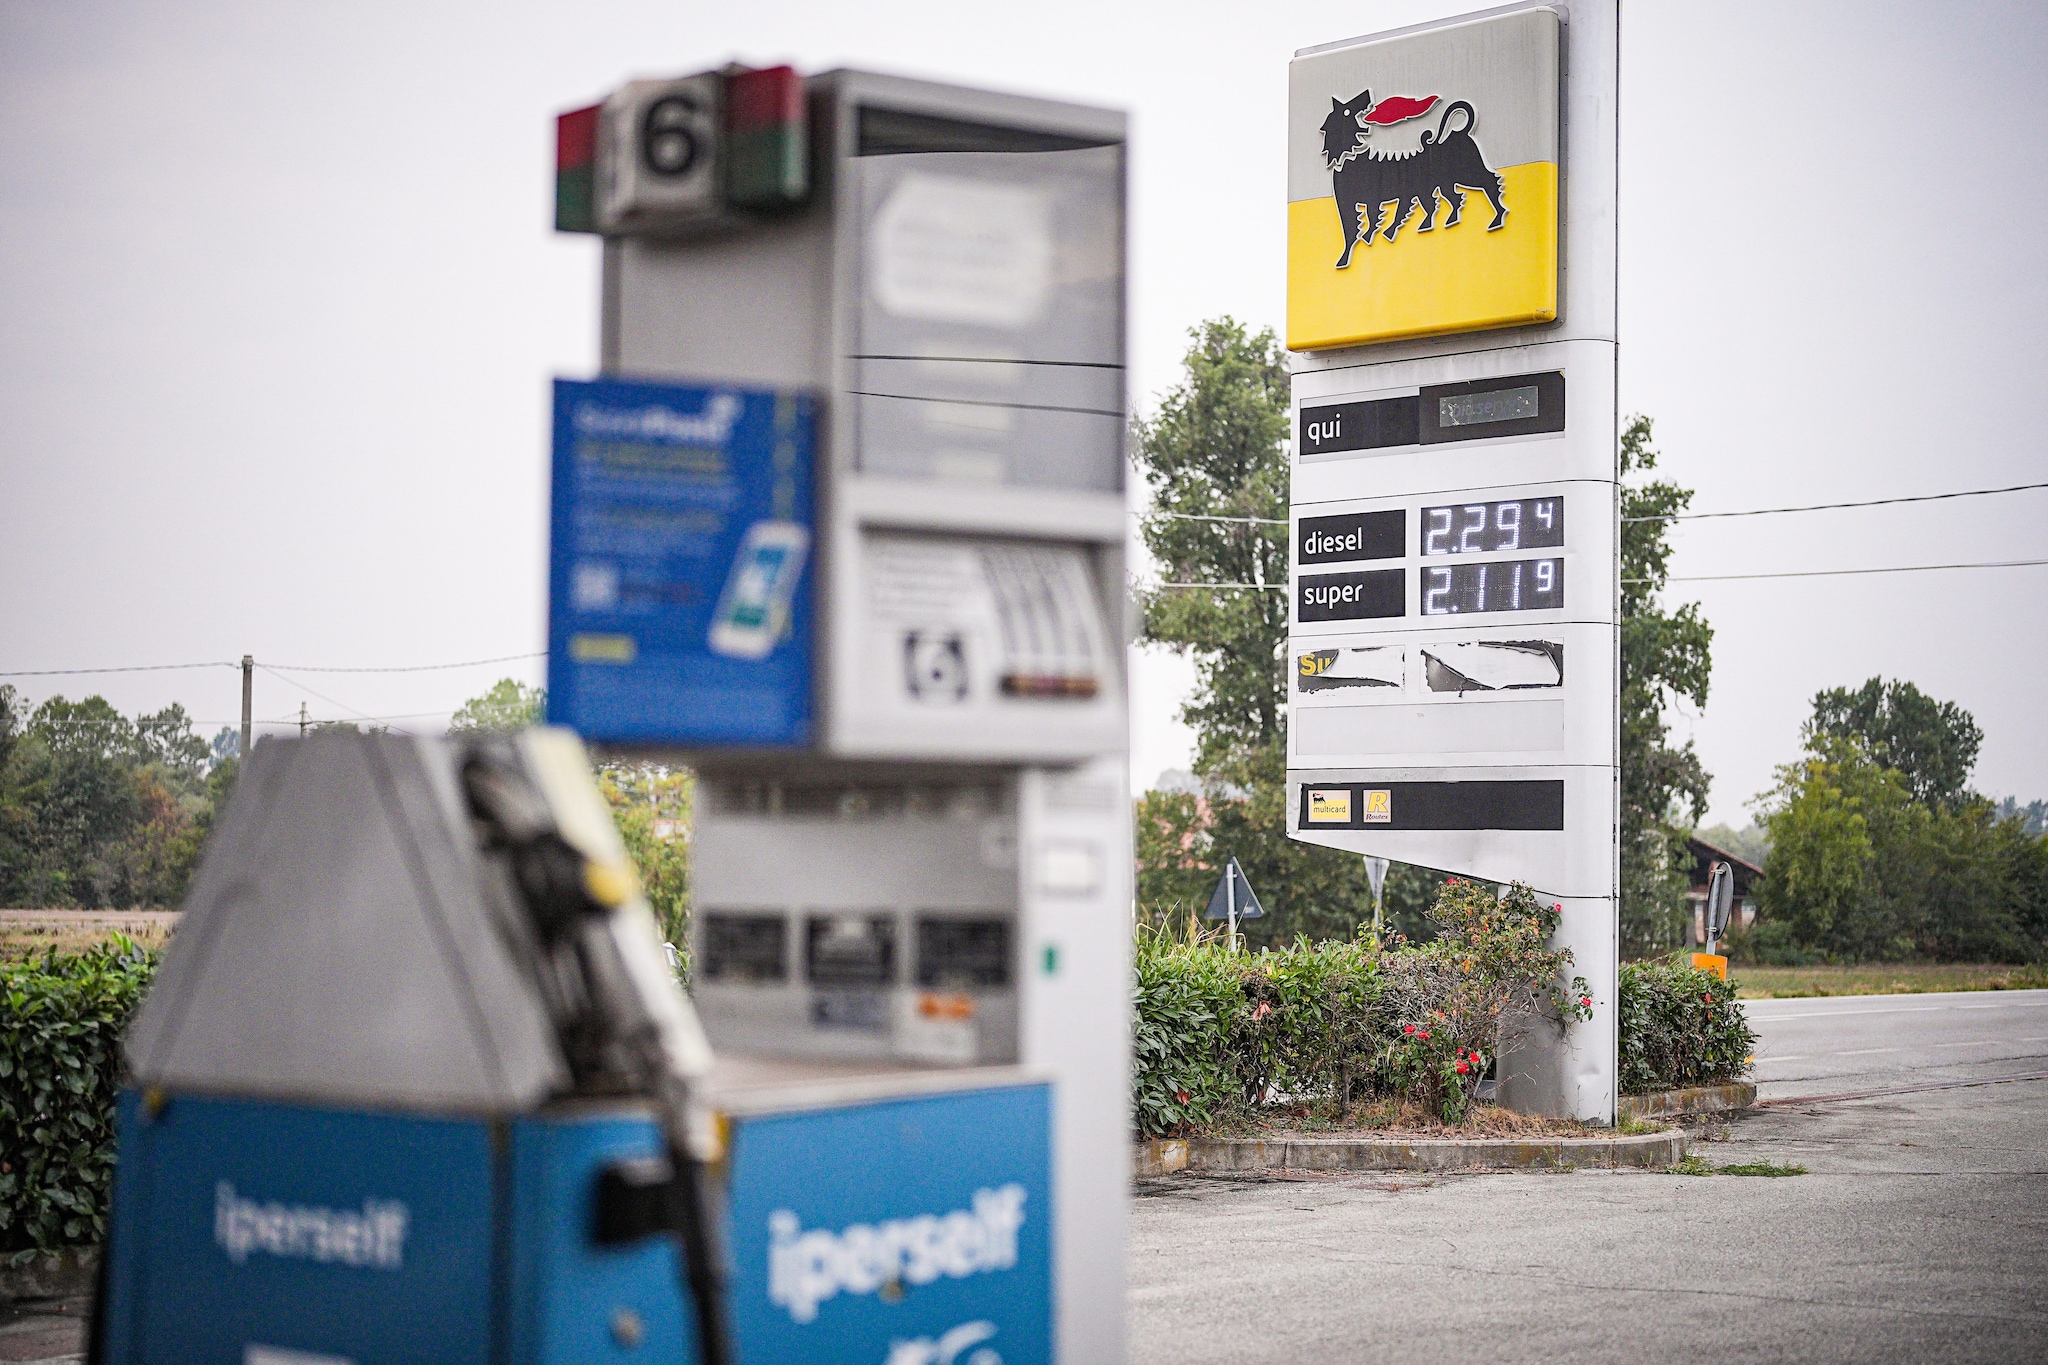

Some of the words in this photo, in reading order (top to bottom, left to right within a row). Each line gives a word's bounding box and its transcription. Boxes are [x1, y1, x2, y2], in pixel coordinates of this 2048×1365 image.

[642, 90, 705, 178] 6
[1307, 413, 1341, 446] qui
[1304, 527, 1363, 555] diesel
[1304, 583, 1363, 609] super
[1313, 805, 1346, 813] multicard
[769, 1184, 1025, 1323] iperself
